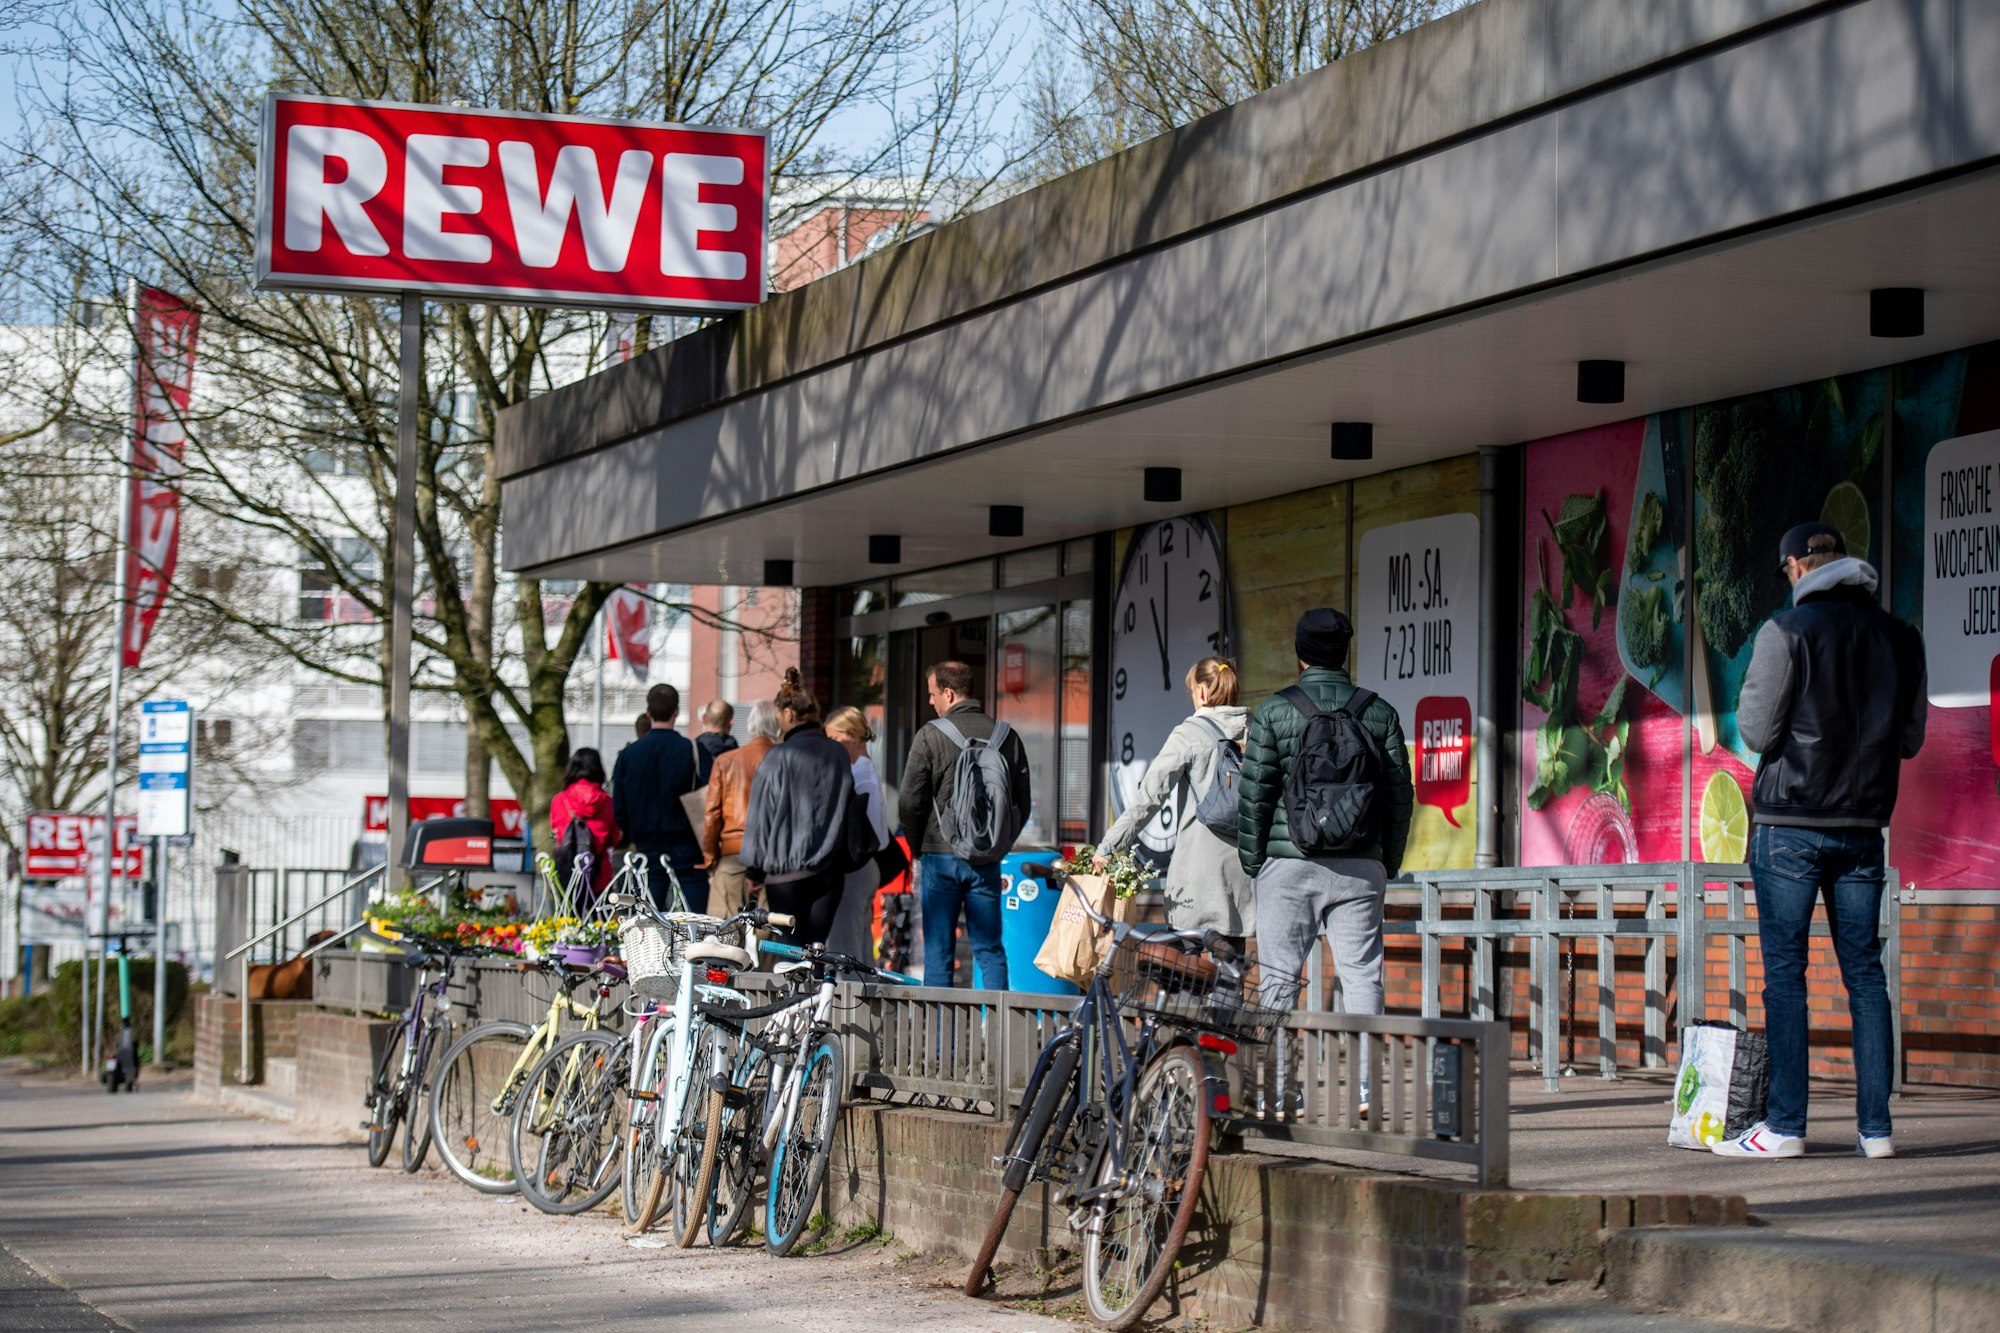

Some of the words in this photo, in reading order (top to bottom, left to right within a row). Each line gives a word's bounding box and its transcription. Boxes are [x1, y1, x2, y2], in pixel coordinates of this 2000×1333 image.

[284, 124, 748, 280] REWE
[1940, 465, 1992, 520] FRISCHE
[1159, 522, 1174, 555] 12
[1140, 552, 1148, 585] 11
[1199, 569, 1211, 602] 2
[1124, 601, 1136, 635] 10
[1963, 585, 2000, 636] JEDE
[1384, 622, 1416, 681] 7-23
[1423, 619, 1452, 677] UHR
[1115, 668, 1127, 700] 9
[1122, 732, 1134, 766] 8
[1422, 718, 1463, 749] REWE
[1422, 752, 1438, 782] DEIN
[1439, 750, 1463, 781] MARKT
